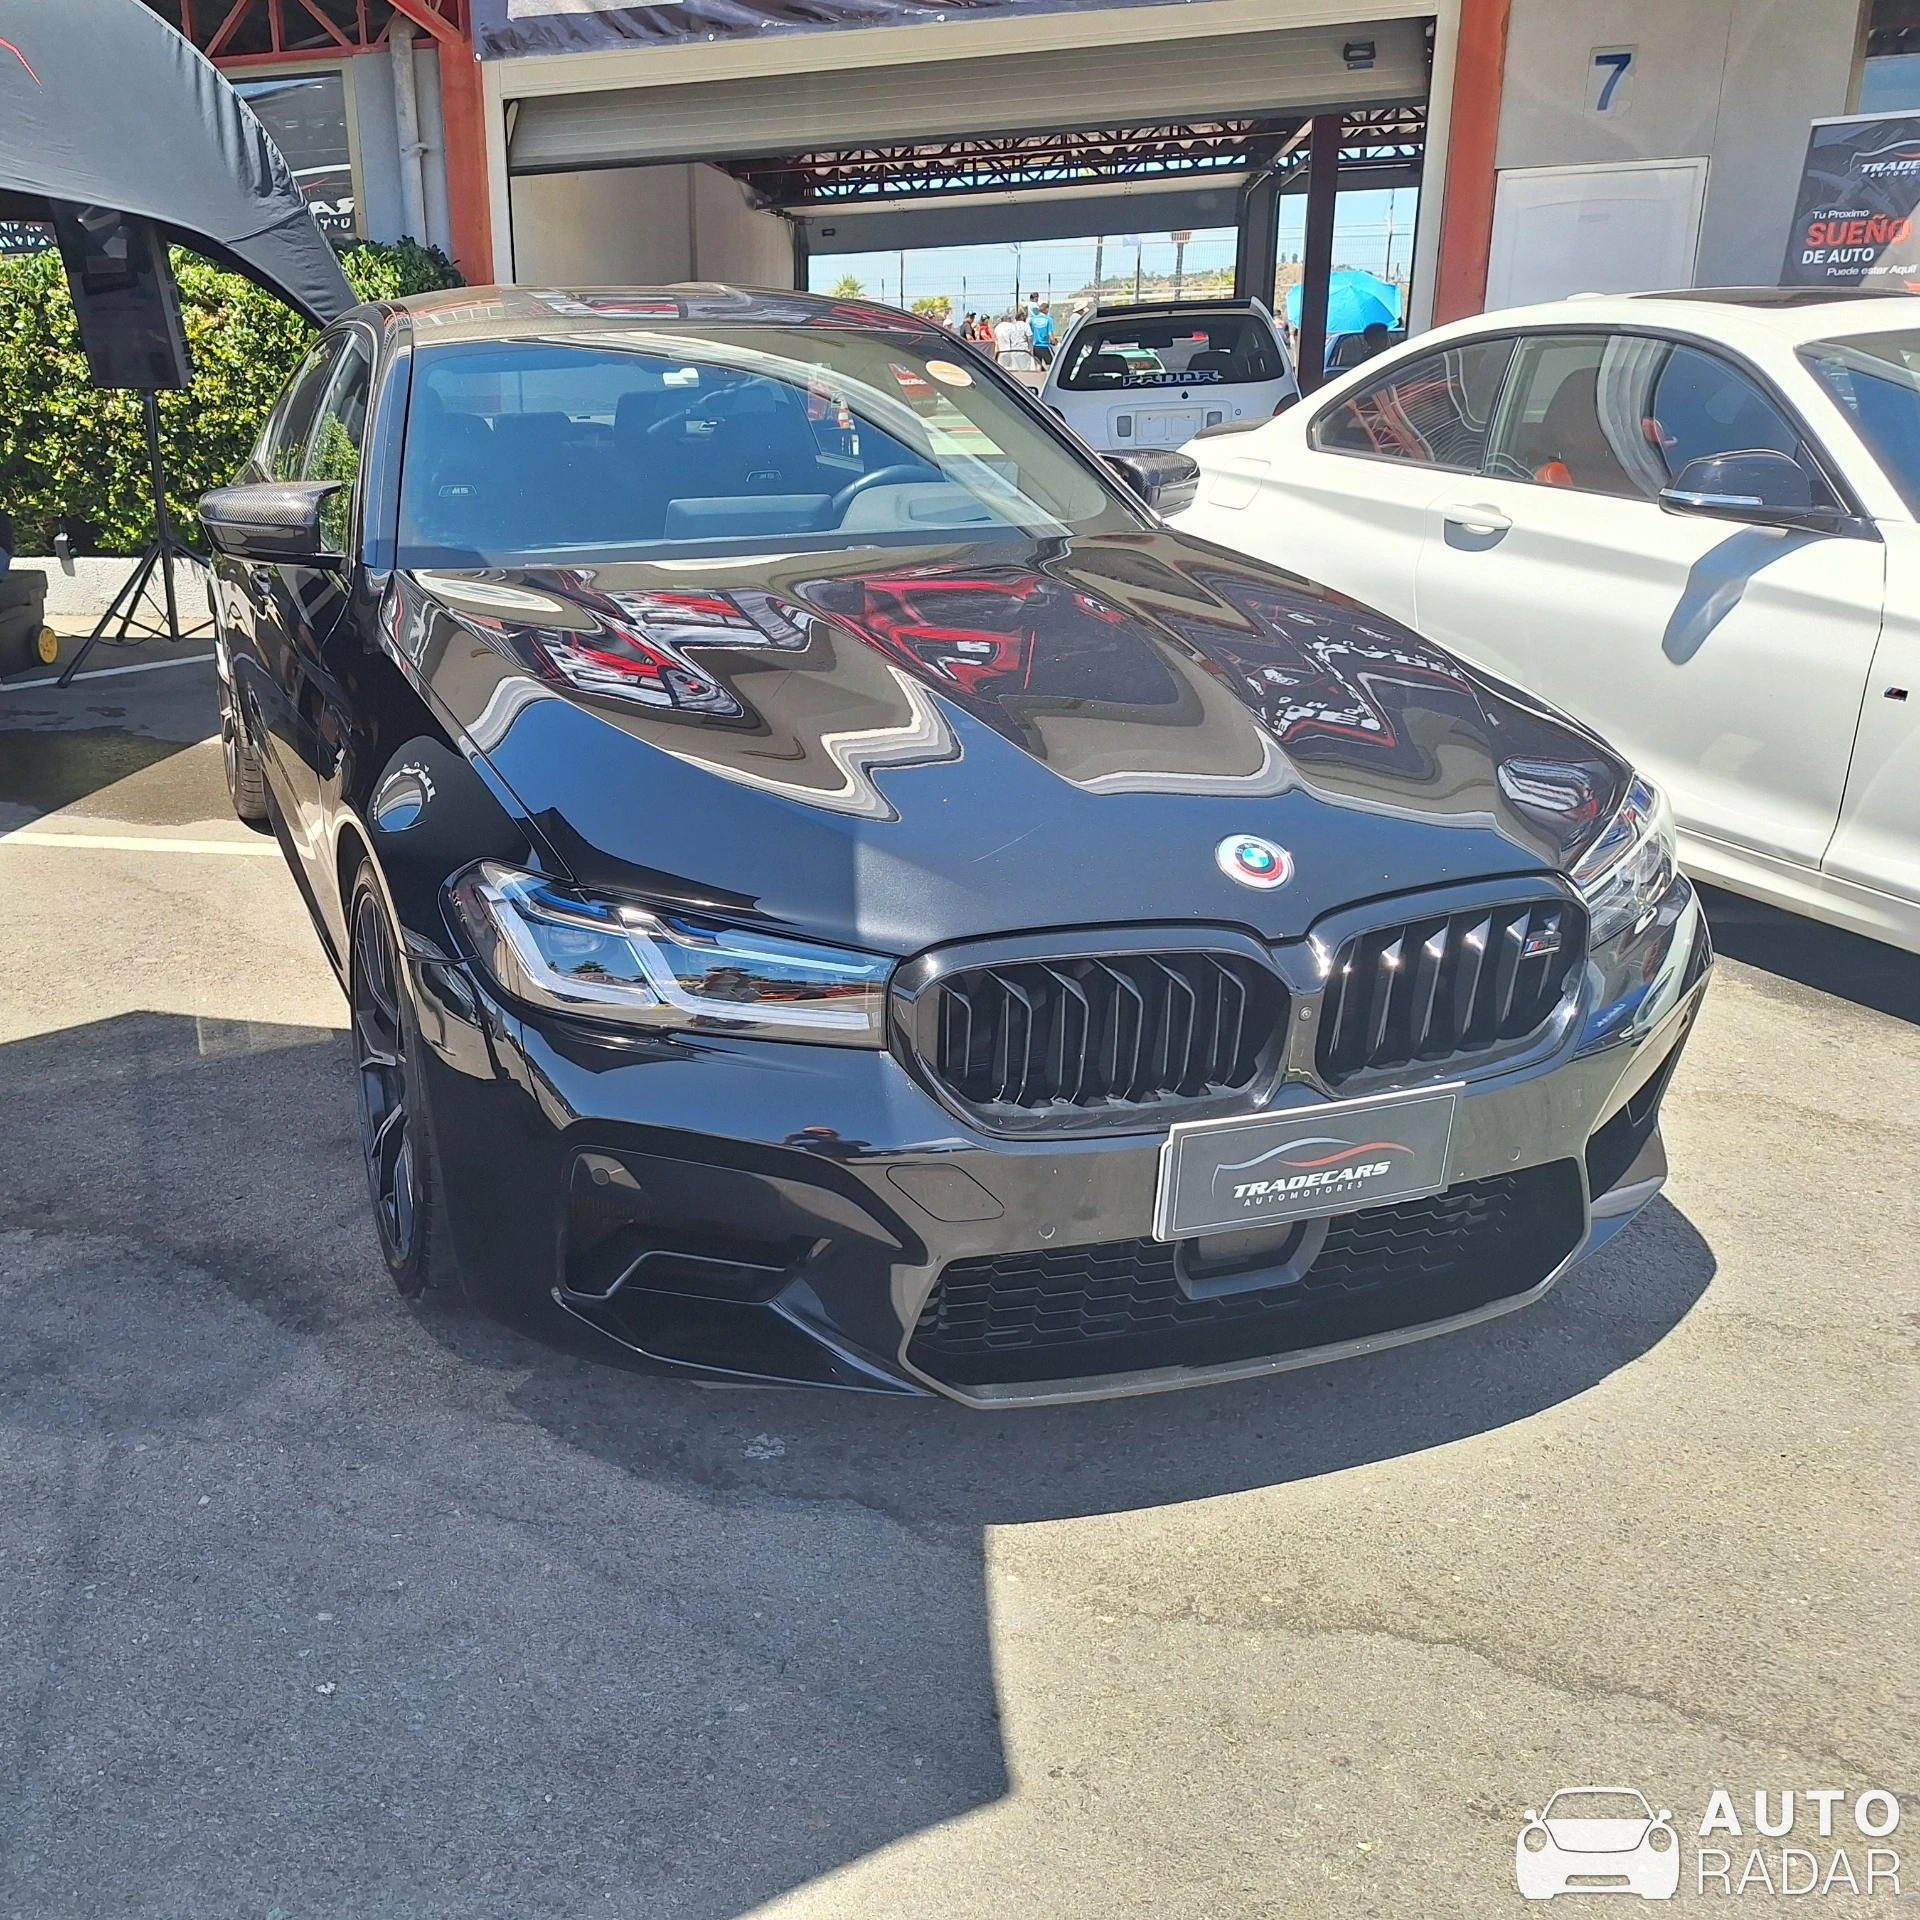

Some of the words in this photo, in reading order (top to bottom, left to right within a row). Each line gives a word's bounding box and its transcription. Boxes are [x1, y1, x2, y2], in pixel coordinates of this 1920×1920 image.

[1595, 53, 1632, 111] 7
[1813, 211, 1826, 220] Tu
[1828, 209, 1870, 219] Proximo
[1806, 213, 1912, 247] SUEÑO
[1802, 249, 1826, 265] DE
[1827, 247, 1875, 264] AUTO
[1827, 266, 1859, 276] Puede
[1861, 265, 1889, 275] estar
[451, 486, 469, 495] M5
[1233, 1161, 1392, 1199] TRADECARS
[1243, 1180, 1364, 1207] AUTOMOTORES
